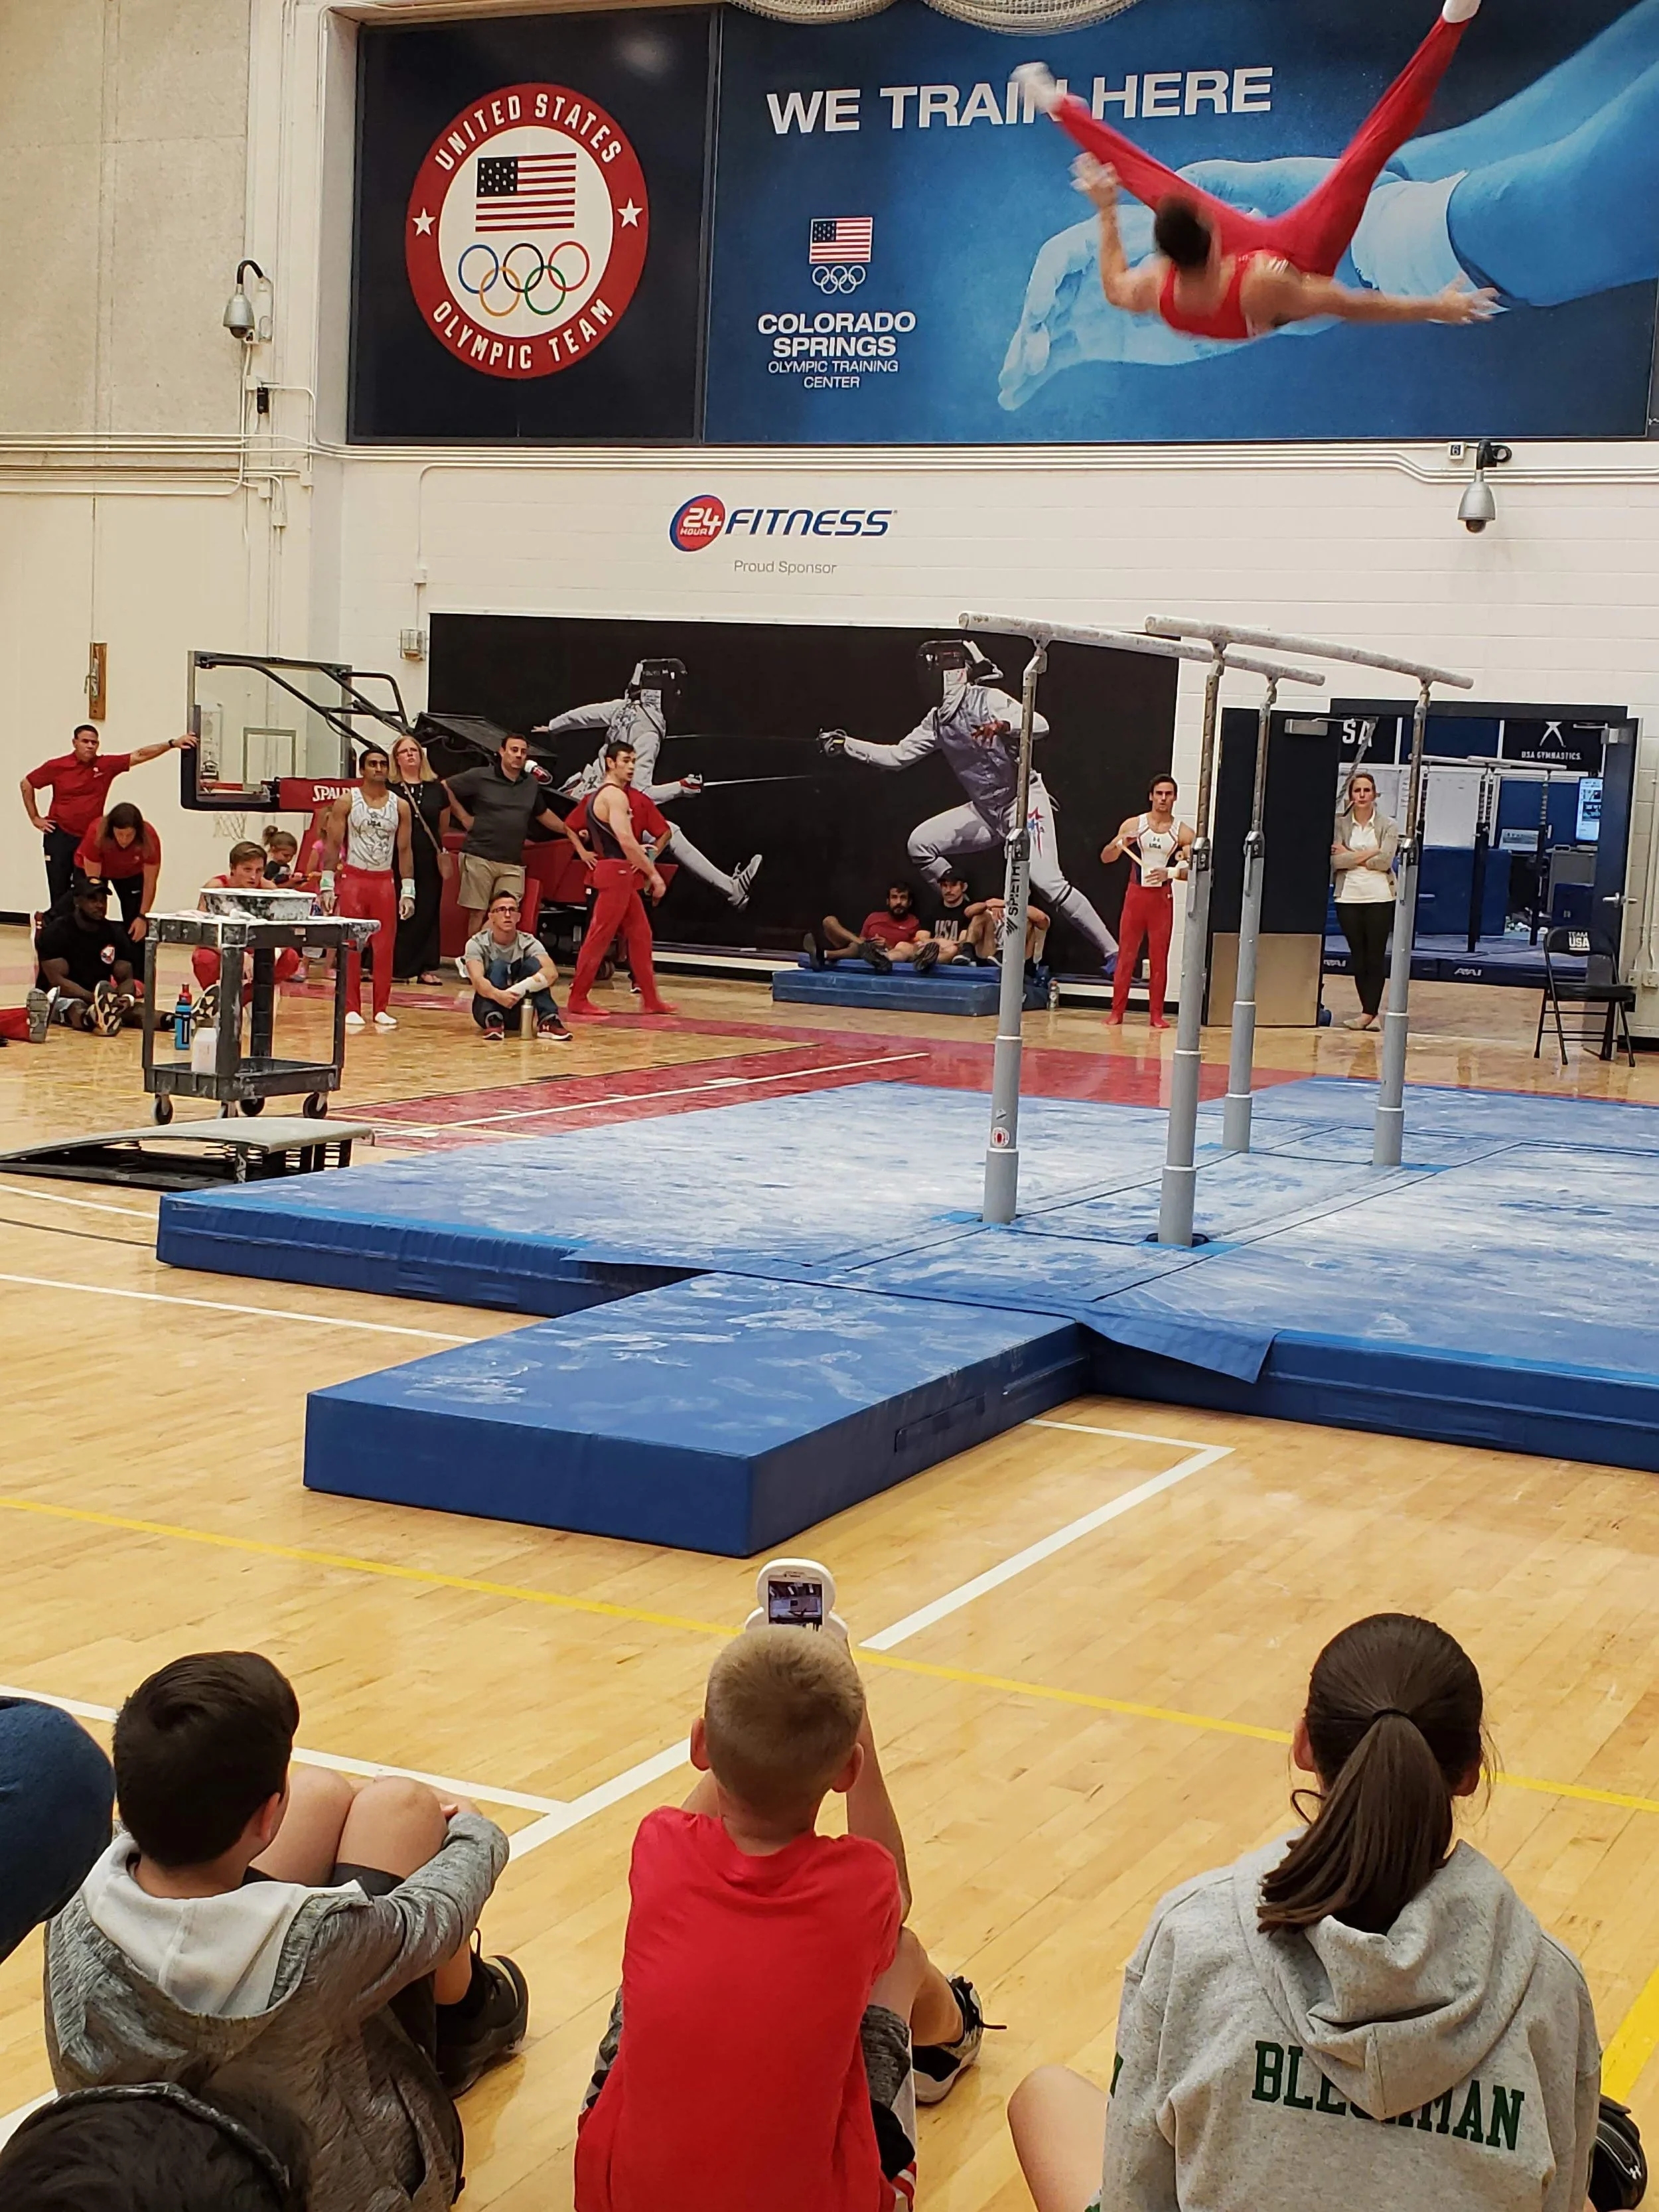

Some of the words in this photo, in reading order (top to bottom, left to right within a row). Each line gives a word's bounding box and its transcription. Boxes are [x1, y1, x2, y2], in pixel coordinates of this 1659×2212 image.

[766, 89, 861, 134] WE
[1092, 67, 1273, 119] HERE
[435, 94, 522, 171] UNITED
[535, 93, 622, 163] STATES
[758, 311, 916, 334] COLORADO
[433, 301, 532, 370] OLYMPIC
[548, 298, 614, 362] TEAM
[773, 336, 896, 358] SPRINGS
[768, 360, 828, 374] OLYMPIC
[831, 360, 899, 372] TRAINING
[804, 376, 861, 388] CENTER
[683, 507, 723, 536] 24
[725, 508, 893, 536] FITNESS
[733, 559, 775, 573] Proud
[778, 561, 837, 575] Sponsor
[1342, 719, 1372, 747] SA
[1537, 751, 1581, 760] GYMNASTICS
[313, 785, 351, 802] SPALD
[935, 920, 958, 941] USA
[1569, 936, 1590, 948] USA
[1252, 2039, 1525, 2151] BLEMAN
